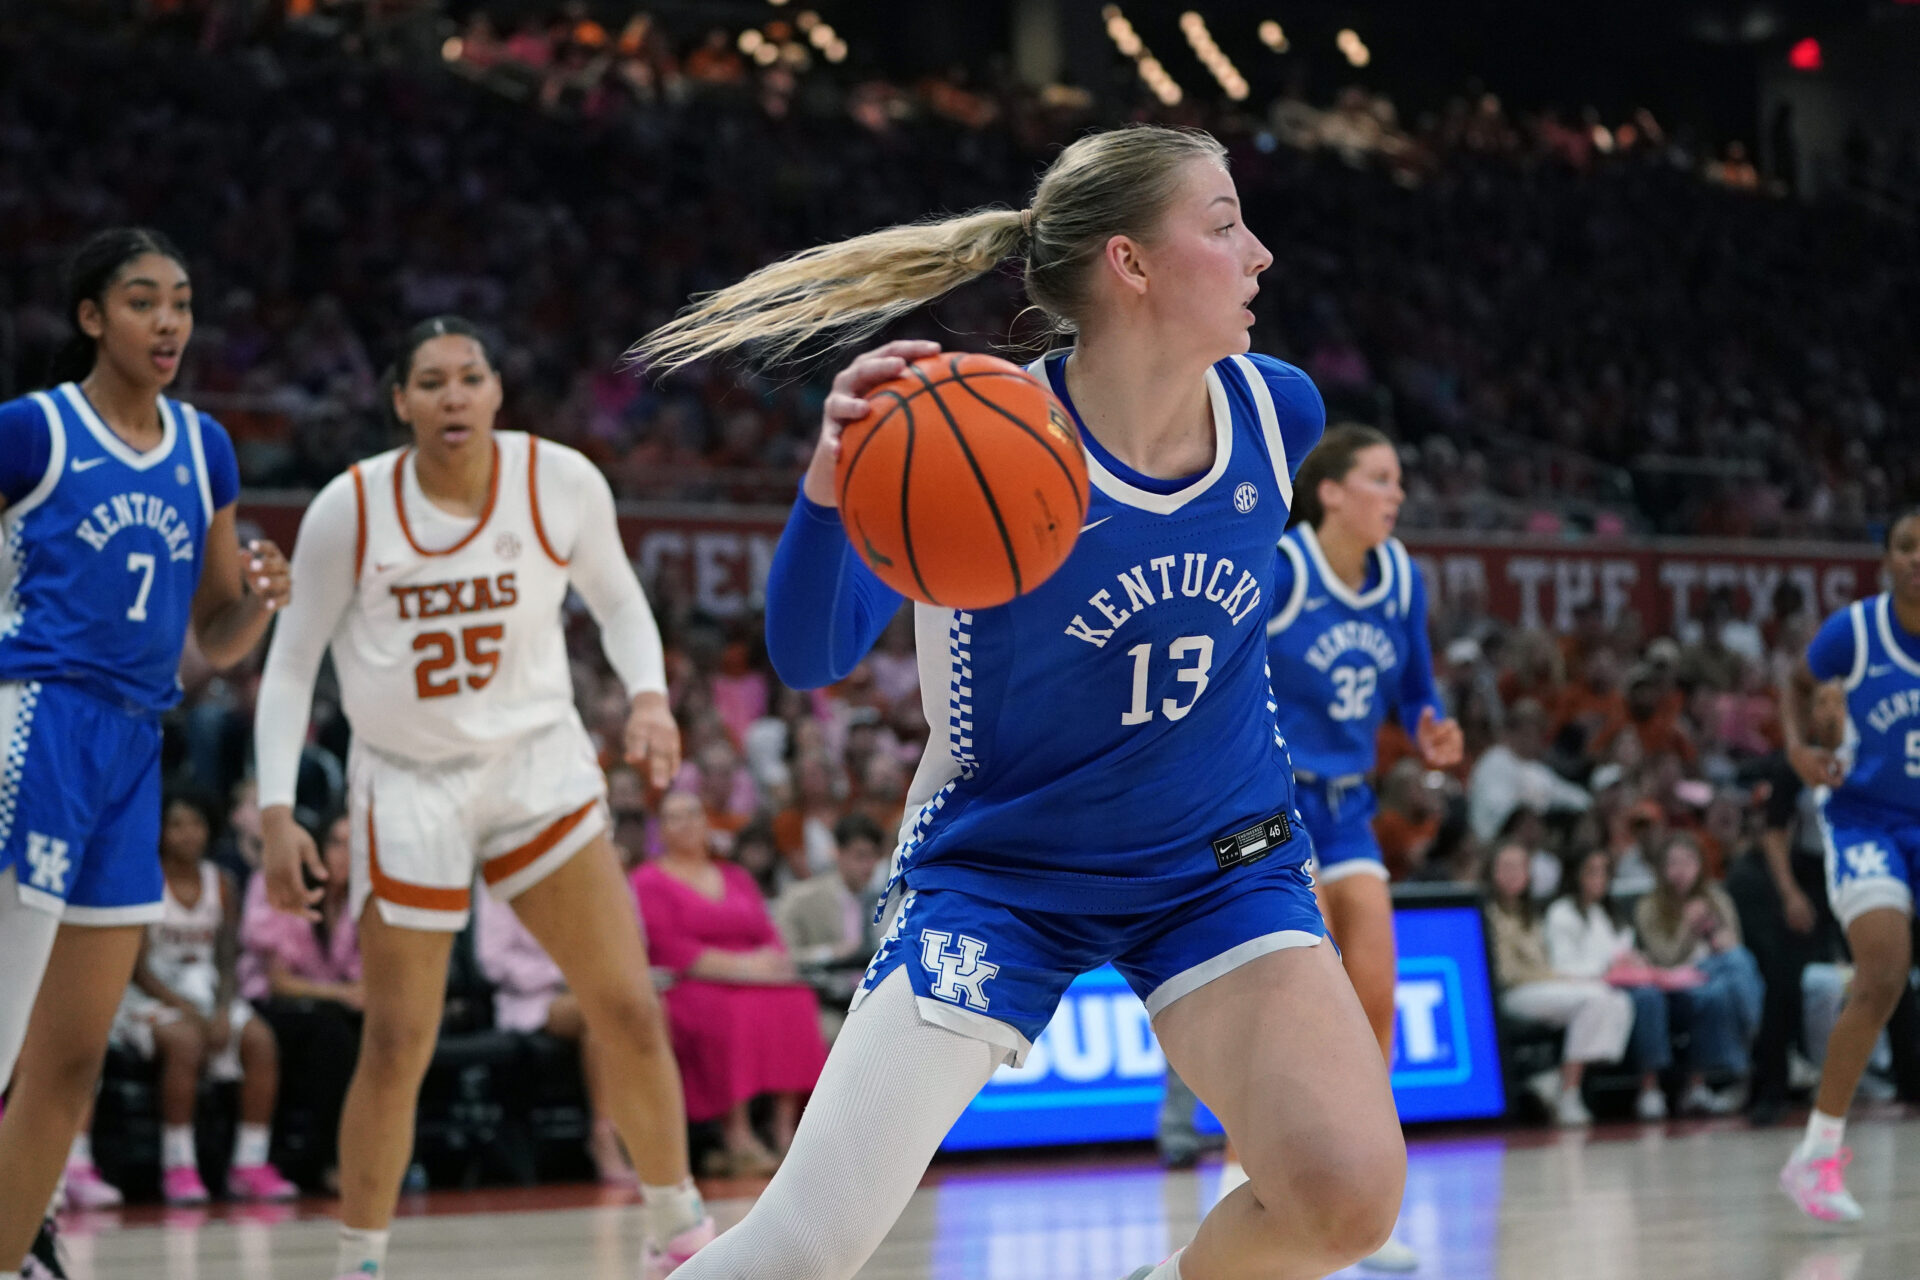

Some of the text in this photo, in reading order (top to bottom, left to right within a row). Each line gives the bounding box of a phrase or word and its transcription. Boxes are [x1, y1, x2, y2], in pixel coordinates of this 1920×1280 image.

[76, 492, 193, 562] KENTUCKY
[1235, 483, 1257, 512] SEC
[126, 552, 156, 621] 7
[390, 572, 518, 620] TEXAS
[1064, 553, 1261, 648] KENTUCKY
[412, 625, 505, 699] 25
[1121, 634, 1214, 726] 13
[1304, 621, 1397, 674] KENTUCKY
[1328, 665, 1378, 721] 32
[1269, 824, 1281, 838] 46
[919, 928, 999, 1012] UK
